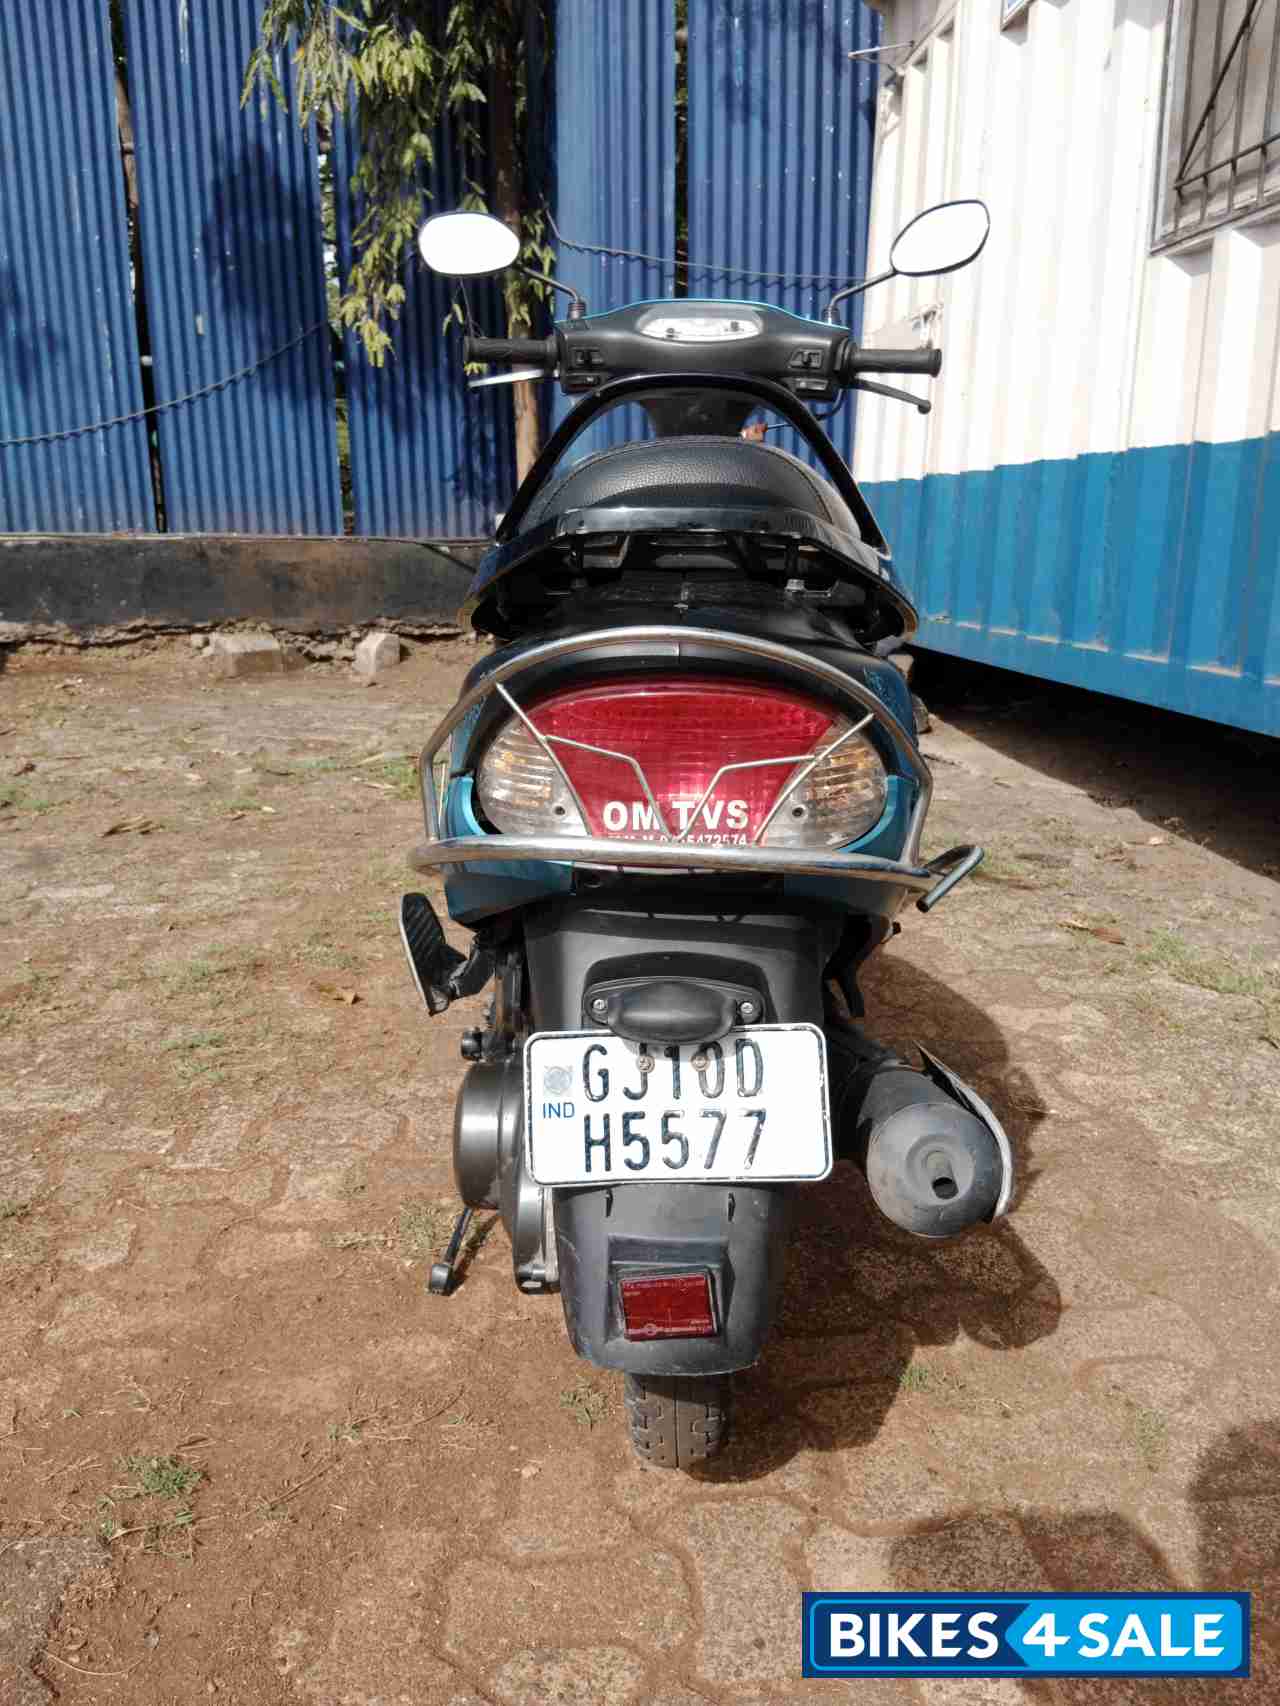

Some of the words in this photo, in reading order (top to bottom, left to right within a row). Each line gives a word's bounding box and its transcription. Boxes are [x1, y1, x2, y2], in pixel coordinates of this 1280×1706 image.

[603, 801, 661, 832] OM
[671, 800, 749, 831] TVS
[543, 1102, 575, 1119] IND
[583, 1109, 767, 1173] H5577
